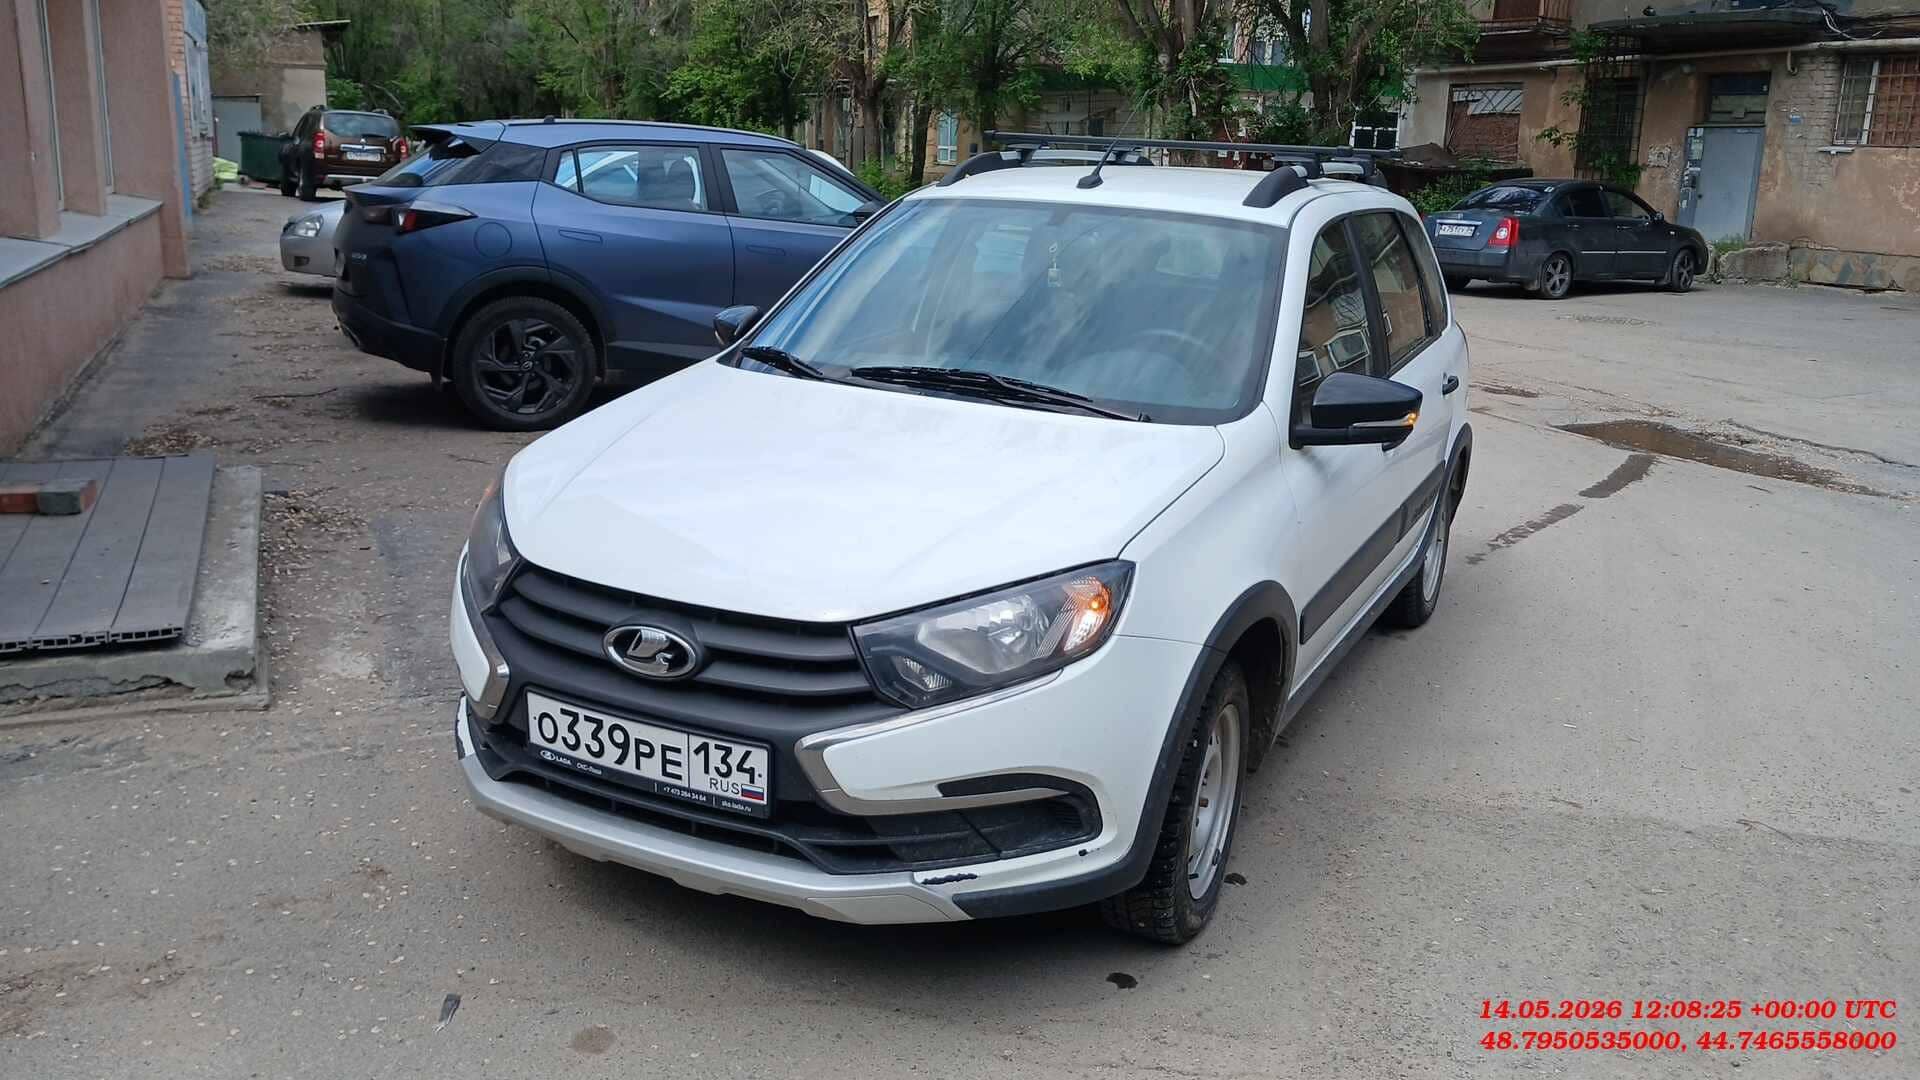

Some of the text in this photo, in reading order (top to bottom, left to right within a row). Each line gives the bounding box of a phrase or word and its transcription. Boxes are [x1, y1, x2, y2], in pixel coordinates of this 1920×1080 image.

[537, 707, 756, 785] О339РЕ 134
[709, 777, 741, 796] RUS
